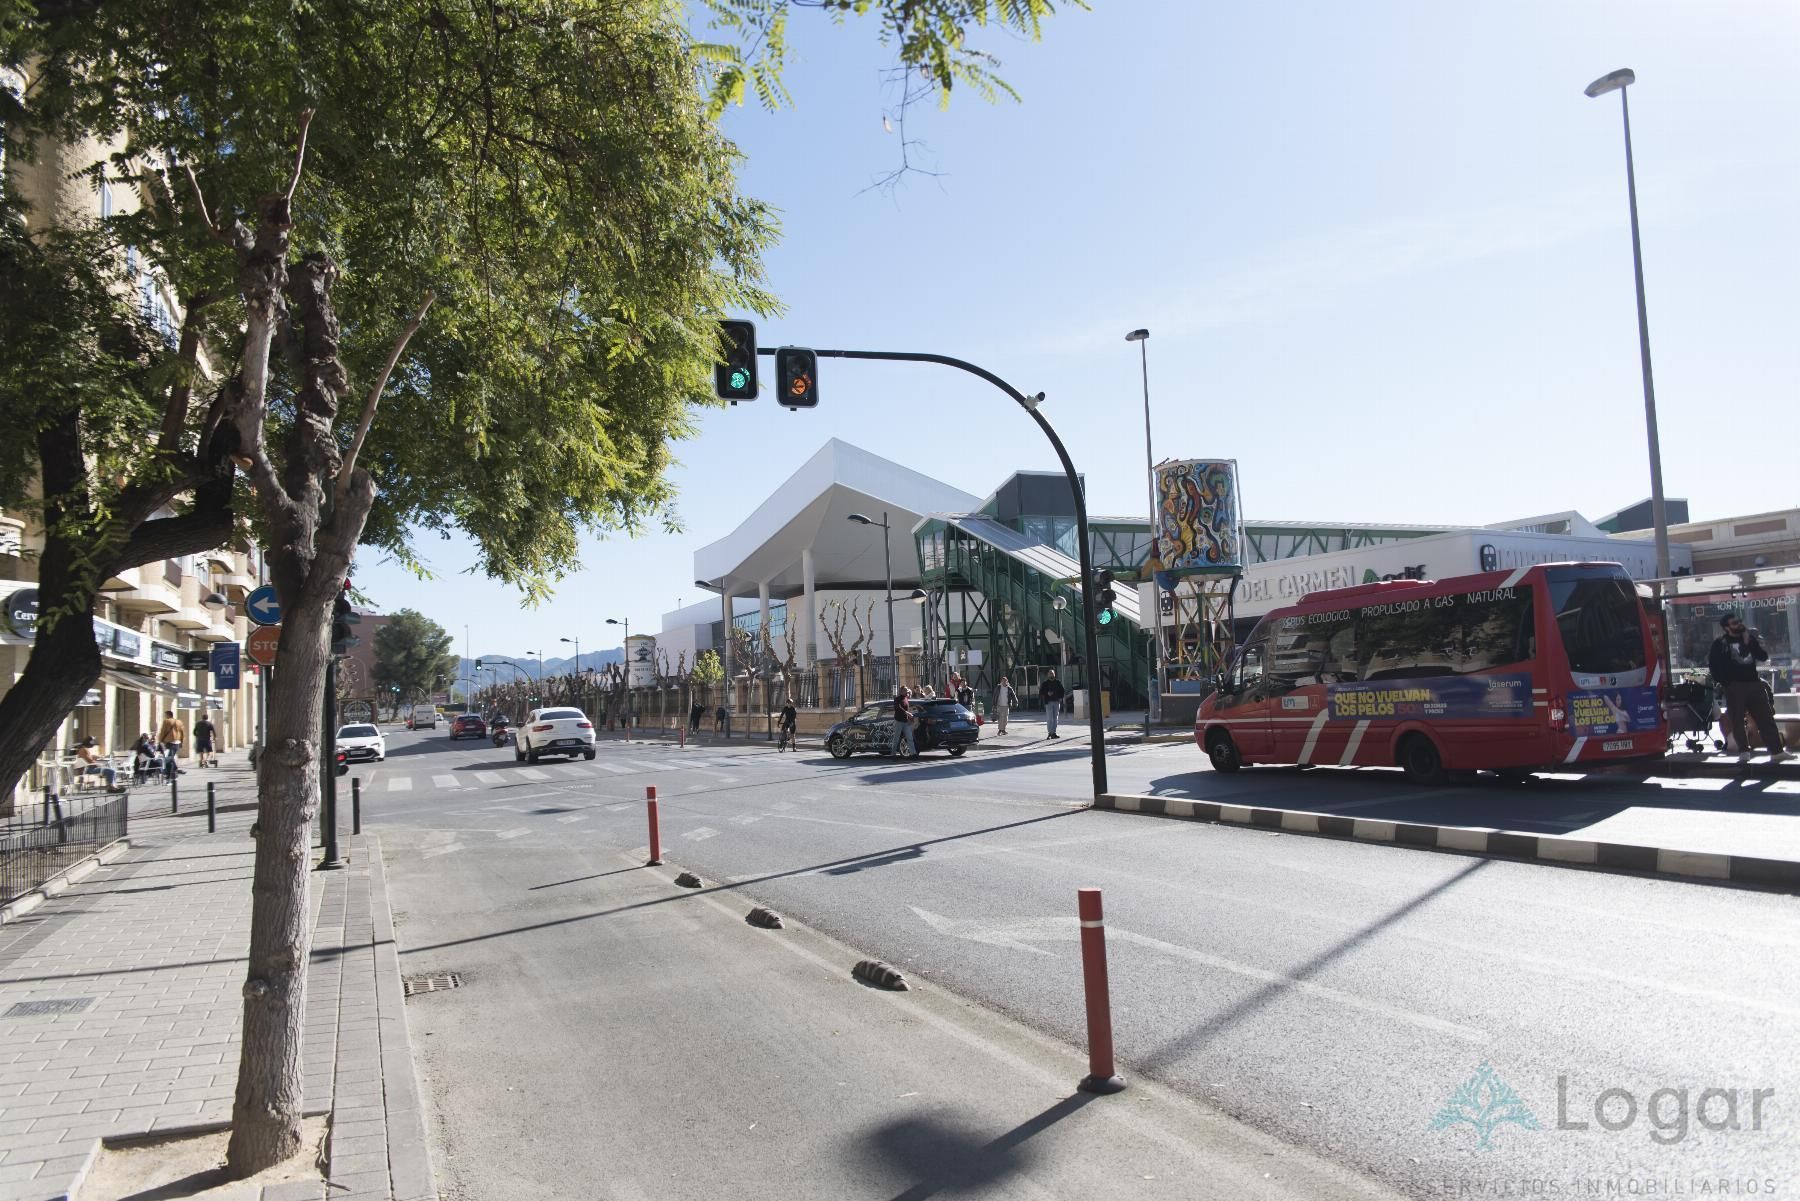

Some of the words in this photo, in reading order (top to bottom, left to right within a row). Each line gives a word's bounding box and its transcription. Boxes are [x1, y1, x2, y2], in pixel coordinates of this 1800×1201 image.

[1241, 577, 1272, 603] DEL
[1278, 565, 1356, 597] CARMEN
[1361, 600, 1420, 618] PROPULSADO
[1423, 598, 1431, 609] A
[1434, 594, 1454, 608] GAS
[1466, 587, 1517, 604] NATURAL
[14, 609, 39, 620] Cerv
[253, 641, 279, 650] STO
[1334, 692, 1357, 705] QUE
[1358, 691, 1376, 704] NO
[1376, 689, 1430, 703] VUELVAN
[1573, 699, 1590, 708] QUE
[1591, 698, 1604, 707] NO
[1336, 704, 1357, 716] LOS
[1358, 703, 1395, 716] PELOS
[1574, 707, 1609, 717] VUELVAN
[1575, 717, 1591, 726] LOS
